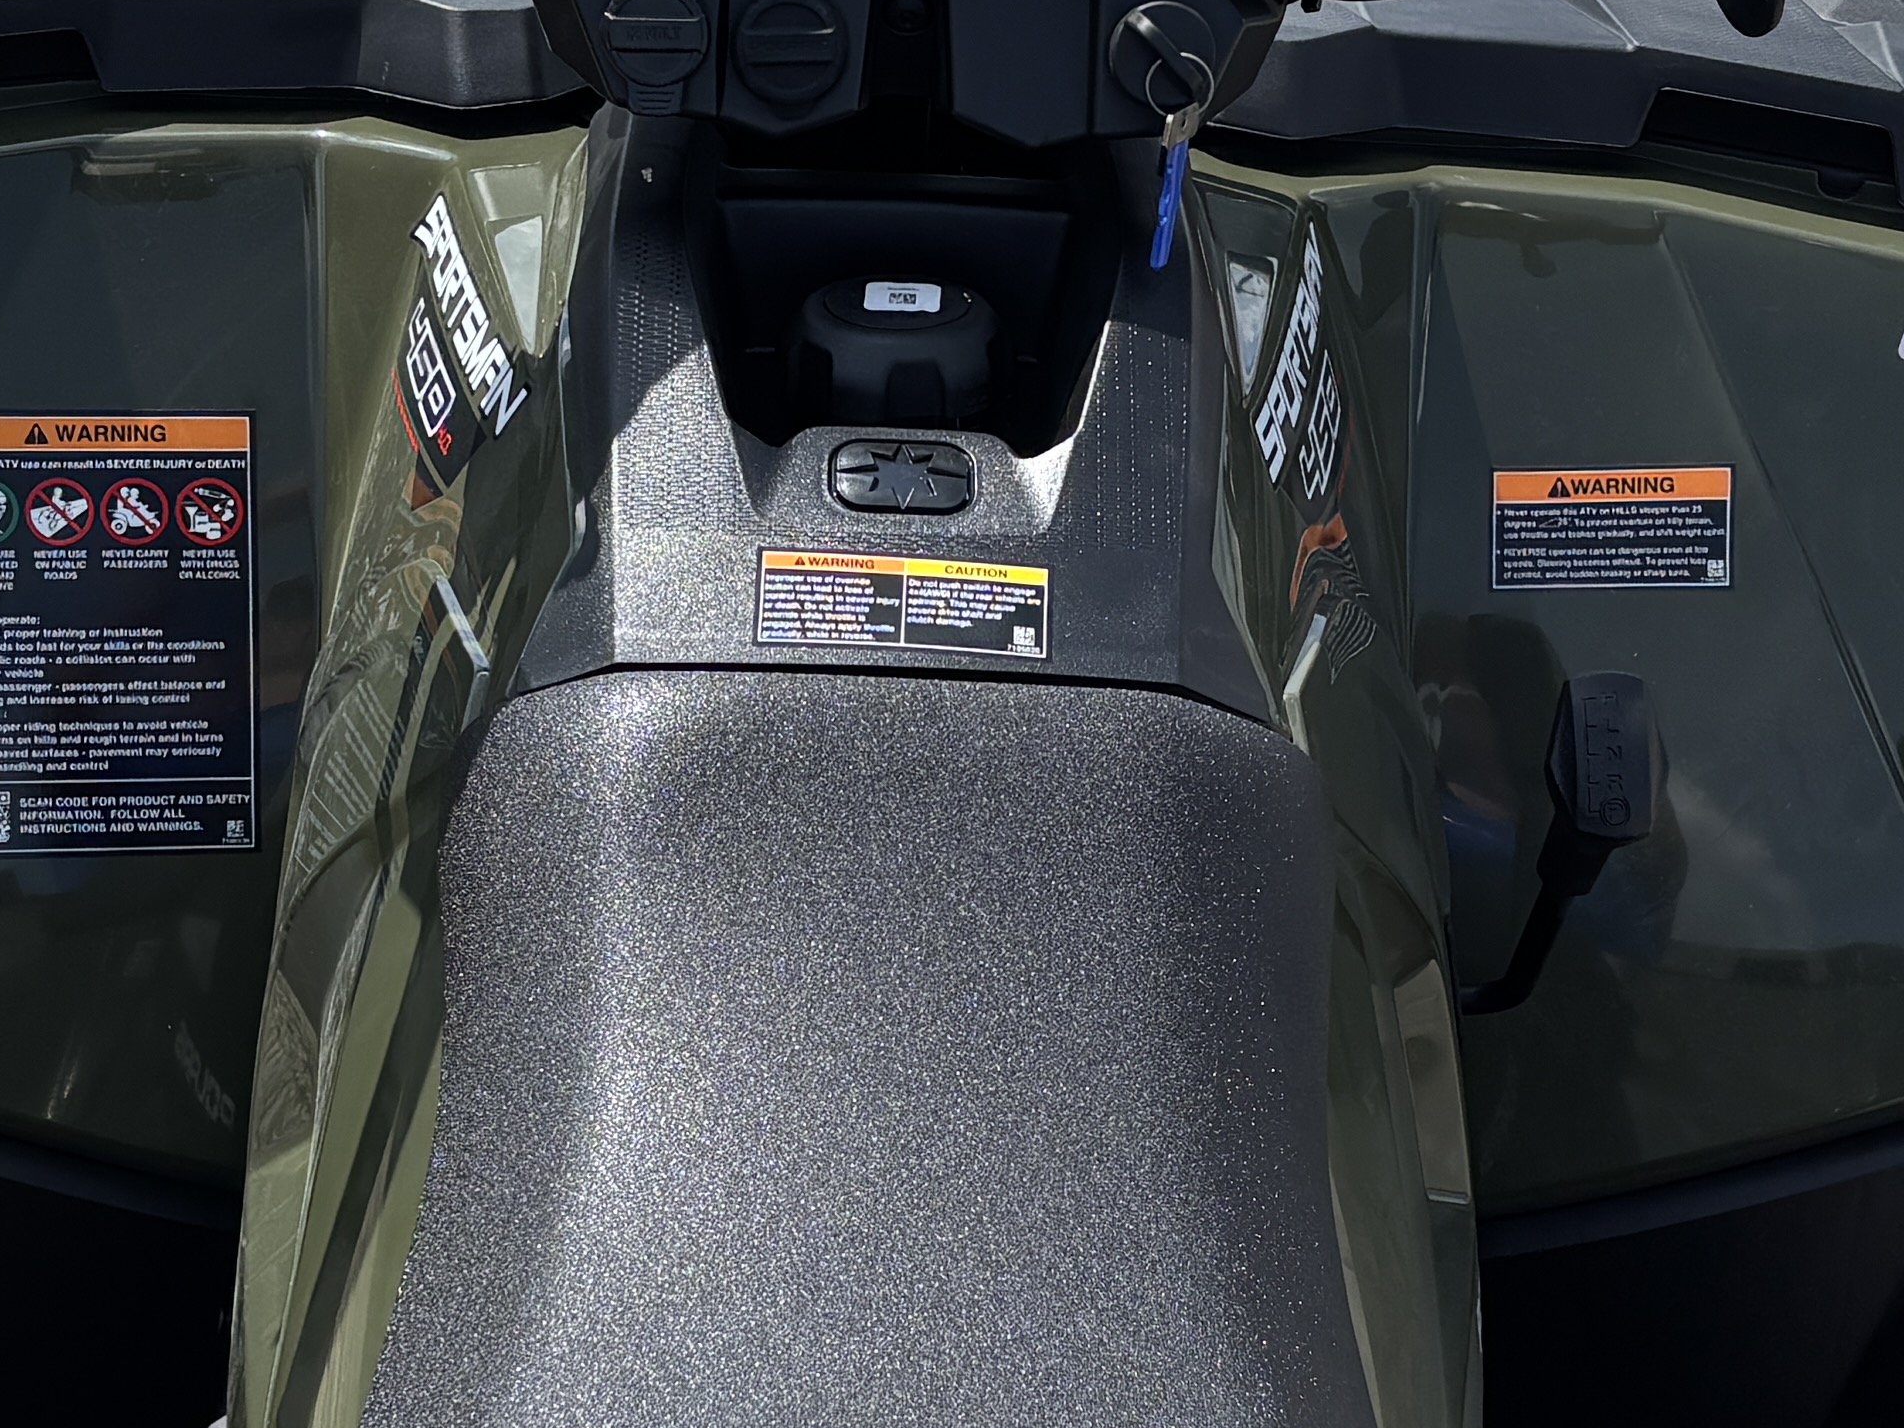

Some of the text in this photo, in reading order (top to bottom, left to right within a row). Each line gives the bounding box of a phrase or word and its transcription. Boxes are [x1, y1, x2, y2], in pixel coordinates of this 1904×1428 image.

[410, 192, 530, 440] SPORTSMAN
[55, 424, 167, 443] WARNING
[106, 459, 151, 469] SEVERE
[153, 459, 193, 469] INJURY
[194, 461, 206, 469] or
[207, 459, 246, 469] DEATH
[1570, 477, 1675, 496] WARNING
[33, 550, 88, 559] NEVER USE
[182, 549, 236, 558] NEVER USE
[807, 556, 875, 570] WARNING
[944, 565, 1008, 579] CAUTION
[3, 629, 40, 640] proper
[42, 628, 86, 640] training
[88, 628, 101, 637] or
[15, 642, 34, 651] too
[36, 641, 57, 651] fast
[59, 641, 75, 651] for
[77, 642, 102, 653] your
[132, 641, 144, 650] or
[147, 641, 164, 650] the
[14, 655, 46, 665] roads
[115, 655, 136, 664] can
[172, 653, 196, 663] with
[6, 695, 27, 705] and
[102, 694, 113, 704] of
[23, 721, 56, 734] riding
[122, 720, 134, 730] to
[136, 720, 167, 730] avoid
[16, 736, 31, 745] on
[83, 733, 117, 746] rough
[119, 732, 156, 744] terrain
[158, 732, 179, 743] and
[181, 732, 193, 743] in
[195, 732, 224, 743] turns
[145, 748, 169, 758] may
[45, 762, 67, 771] and
[69, 759, 109, 771] control
[18, 794, 251, 809] SCAN CODE FOR PRODUCT AND SAFETY
[19, 808, 185, 821] INFORMATION. FOLLOW ALL
[19, 820, 204, 835] INSTRUCTIONS AND WARNINGS.
